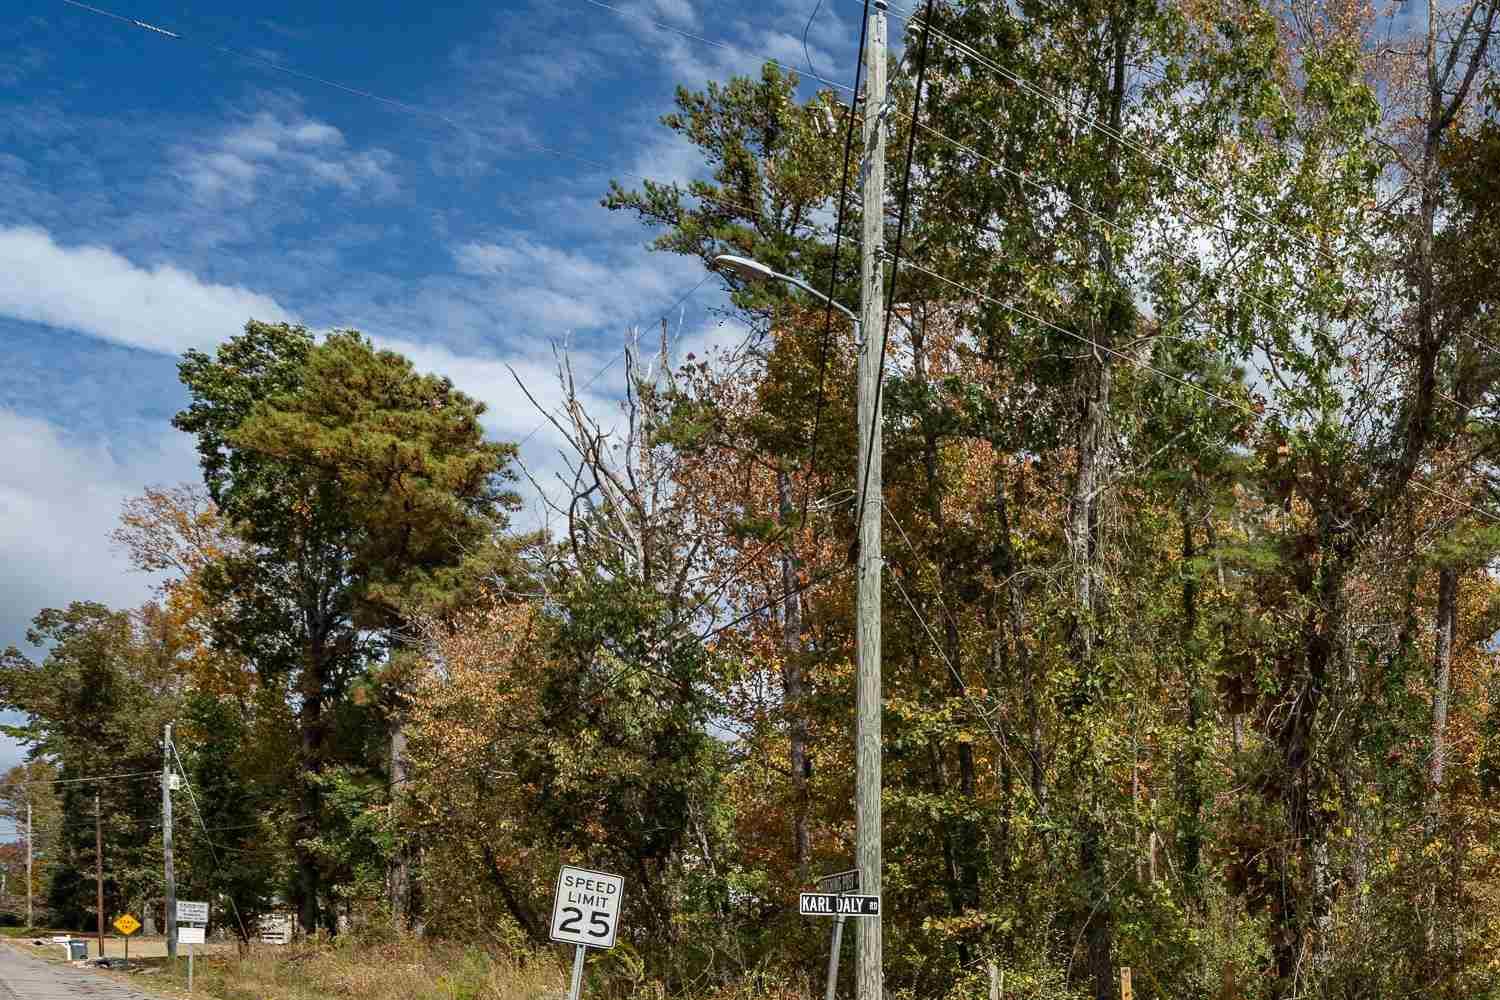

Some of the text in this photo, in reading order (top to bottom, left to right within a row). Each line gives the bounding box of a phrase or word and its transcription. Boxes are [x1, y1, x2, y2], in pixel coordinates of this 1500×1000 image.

[564, 875, 617, 895] SPEED
[568, 891, 609, 909] LIMIT
[802, 895, 833, 913] KARL
[836, 897, 864, 913] DALY
[559, 906, 610, 938] 25
